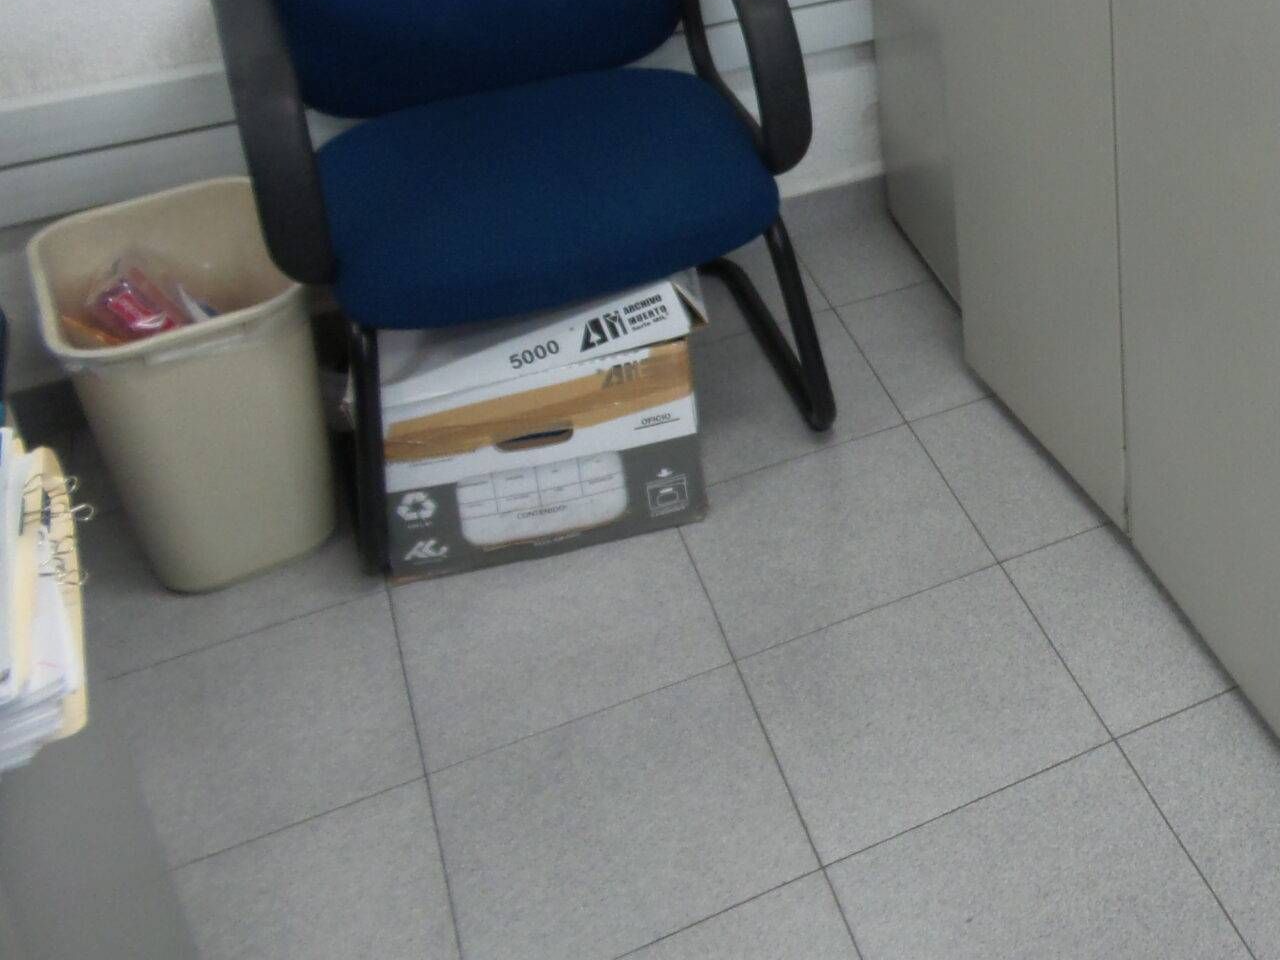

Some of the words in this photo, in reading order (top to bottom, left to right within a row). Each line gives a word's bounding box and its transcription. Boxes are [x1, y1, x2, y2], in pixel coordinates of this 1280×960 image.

[622, 294, 663, 316] ARCHIVO
[627, 304, 668, 326] MUERTO
[508, 339, 561, 370] 5000
